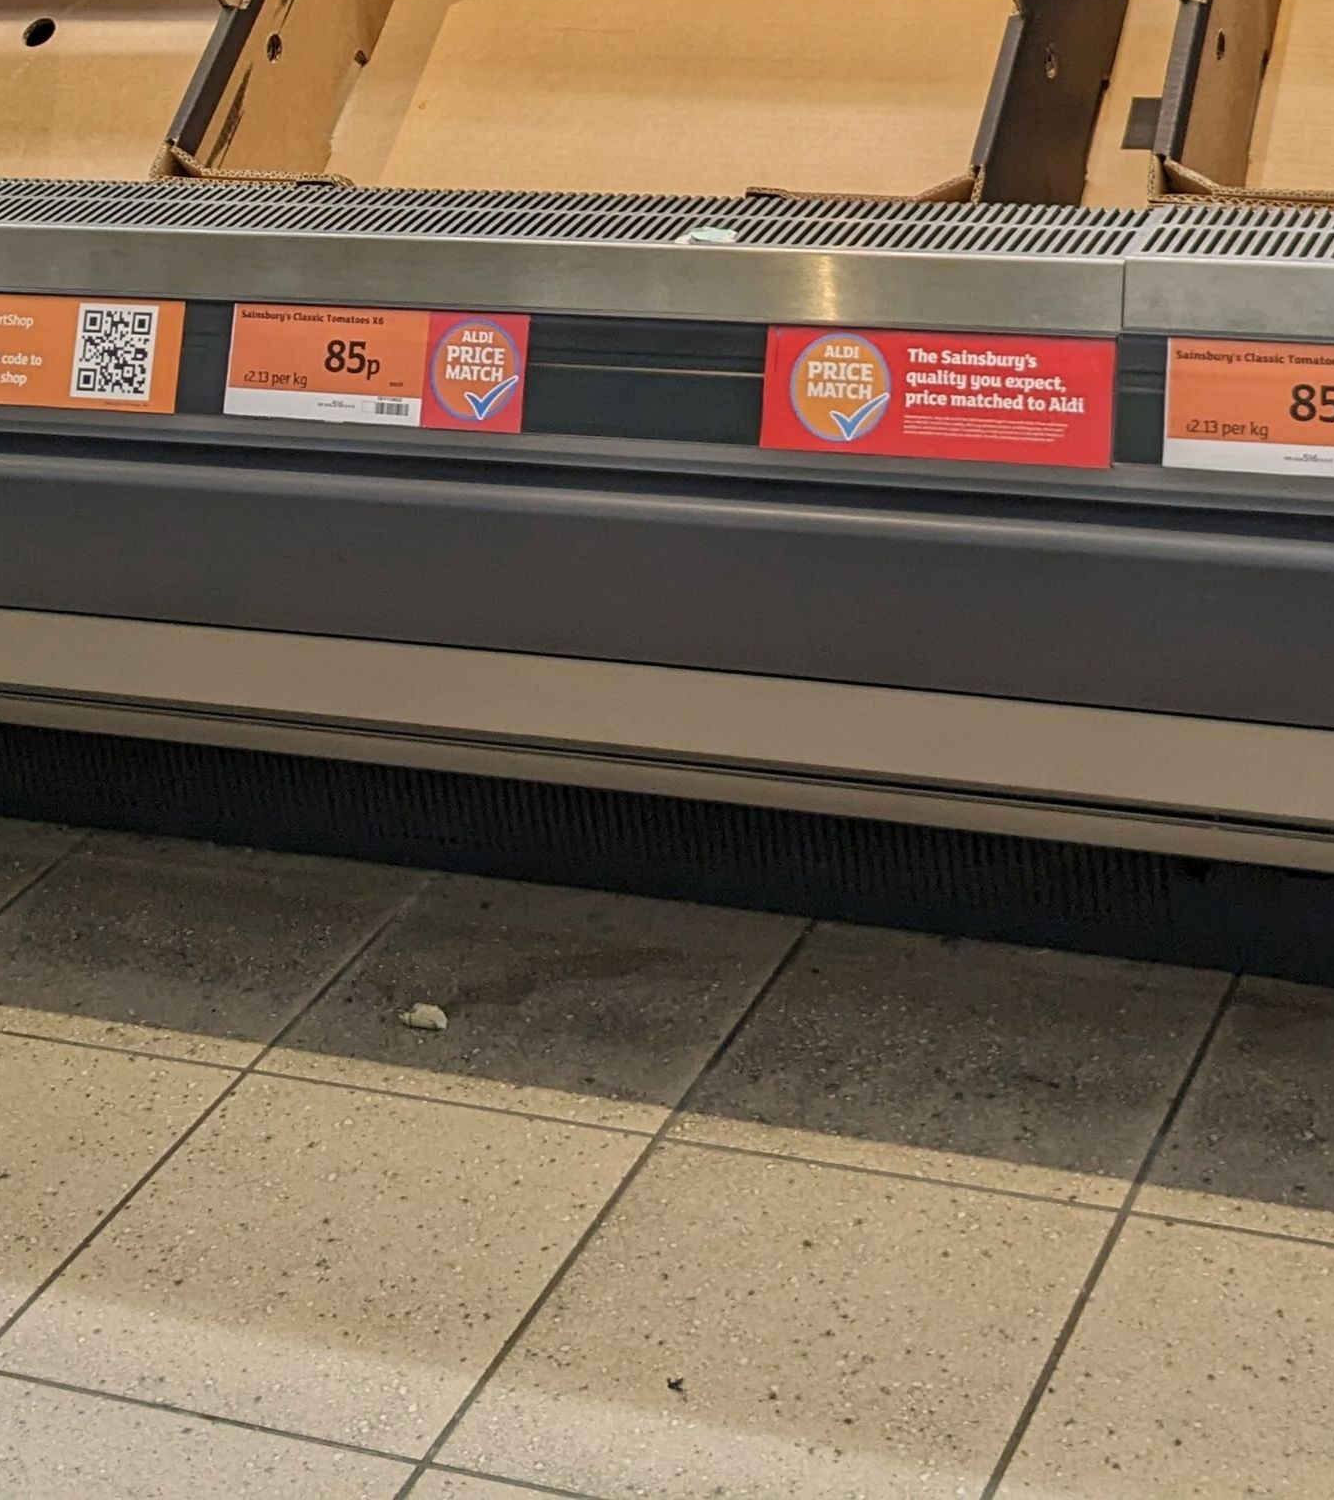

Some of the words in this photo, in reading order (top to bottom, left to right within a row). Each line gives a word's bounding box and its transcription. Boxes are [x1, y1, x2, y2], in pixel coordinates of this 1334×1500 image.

[241, 310, 291, 322] Sainsbury's
[293, 313, 324, 323] Classic
[327, 314, 369, 325] Tomatoes
[462, 331, 494, 343] ALDI
[2, 354, 28, 365] code
[30, 355, 42, 365] to
[324, 340, 380, 379] 85p
[447, 345, 505, 364] PRICE
[824, 345, 860, 359] ALDI
[907, 349, 937, 364] The
[941, 349, 1037, 369] Sainsbury's
[1176, 350, 1242, 365] Sainsbury's
[1244, 352, 1285, 364] Classic
[0, 373, 27, 386] shop
[271, 373, 290, 385] per
[293, 372, 308, 388] kg
[445, 365, 503, 381] MATCH
[807, 361, 873, 382] PRICE
[807, 381, 873, 399] MATCH
[906, 371, 967, 389] quality
[971, 374, 1002, 391] you
[1005, 375, 1066, 393] expect,
[905, 391, 947, 408] price
[951, 392, 1023, 409] matched
[1027, 397, 1045, 411] to
[1049, 397, 1084, 413] Aldi
[1222, 421, 1248, 438] per
[1250, 420, 1269, 440] kg
